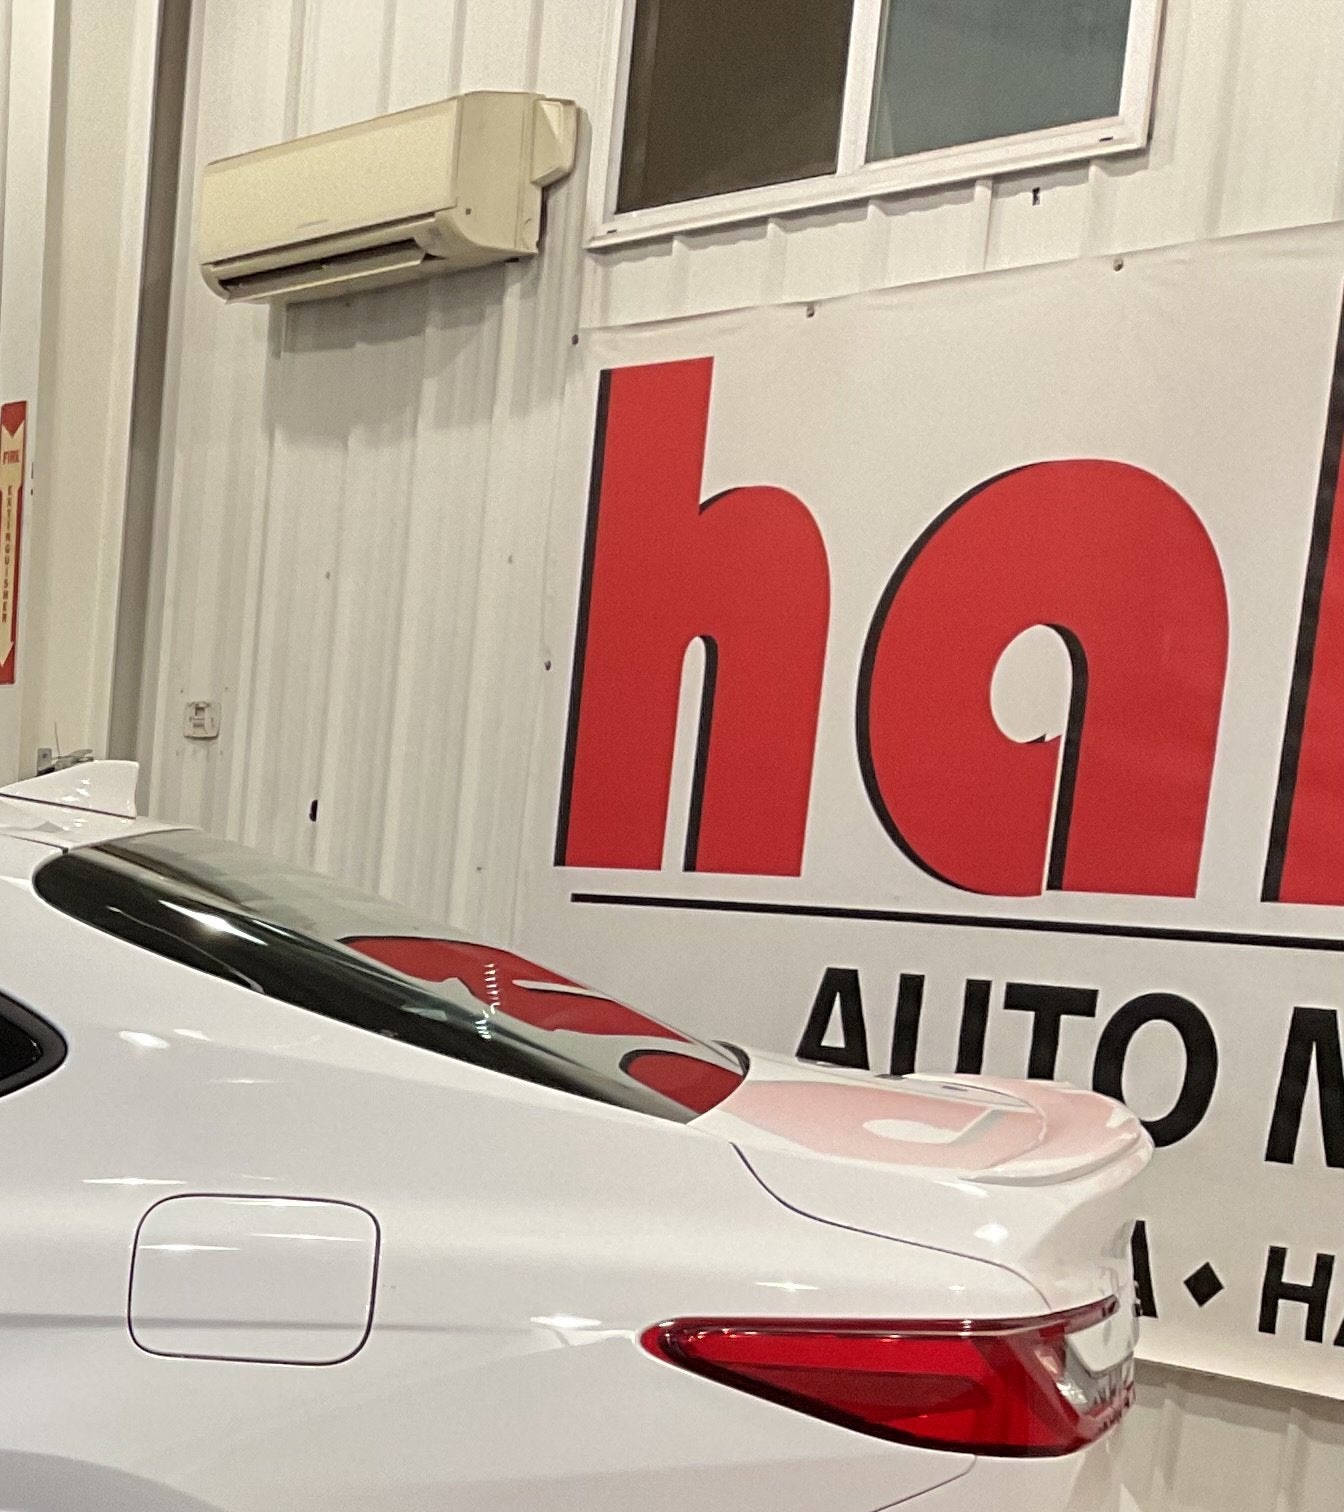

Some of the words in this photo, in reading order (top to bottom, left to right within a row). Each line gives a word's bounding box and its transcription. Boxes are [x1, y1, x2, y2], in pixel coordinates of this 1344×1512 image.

[3, 449, 20, 464] FIRE
[1, 485, 13, 623] EXTINGUISHER
[796, 966, 1218, 1149] AUTO
